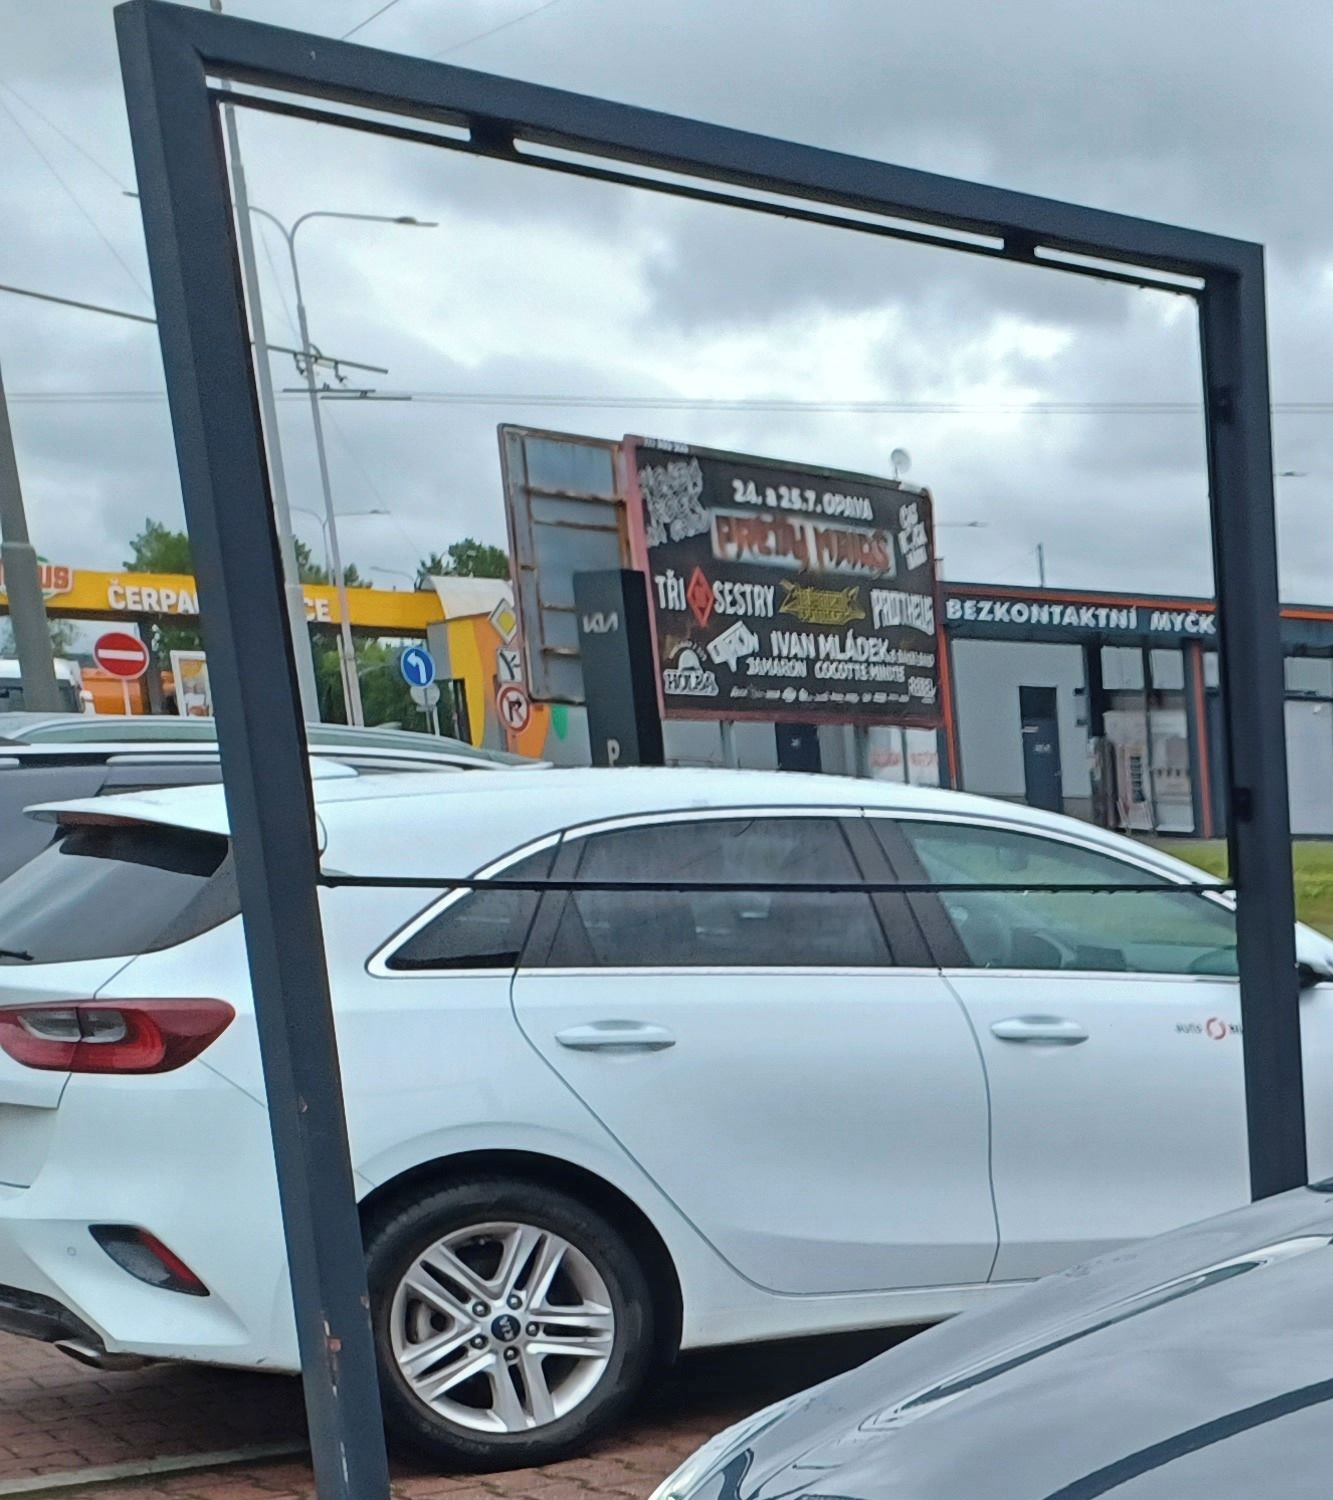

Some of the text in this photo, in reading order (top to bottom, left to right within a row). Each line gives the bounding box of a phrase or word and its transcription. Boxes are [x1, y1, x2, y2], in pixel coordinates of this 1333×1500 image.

[823, 491, 874, 521] OPAVA
[107, 577, 199, 615] ČERPA
[654, 568, 687, 611] TŘI
[712, 580, 775, 618] SESTRY
[583, 612, 618, 633] KIA
[945, 599, 1217, 635] BEZKONTAKTNÍ MYČK
[770, 630, 816, 659] IVAN
[817, 628, 889, 662] MLÁDEK
